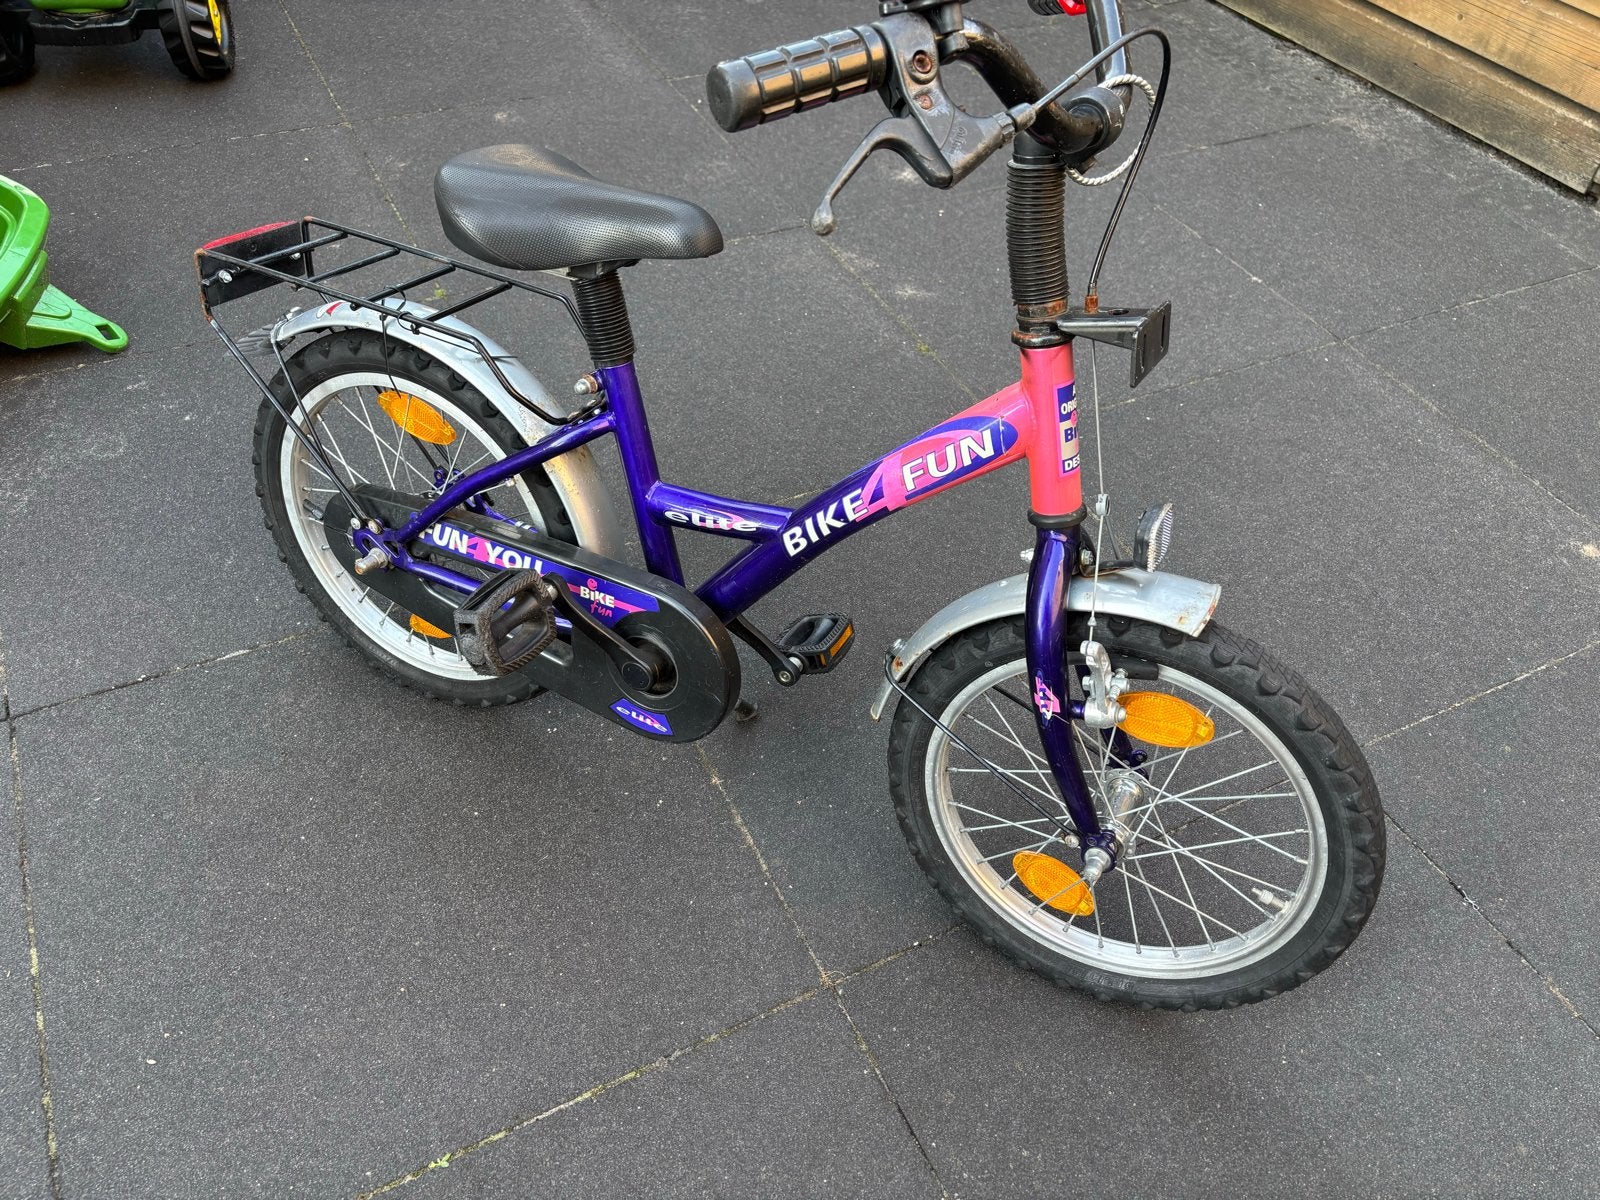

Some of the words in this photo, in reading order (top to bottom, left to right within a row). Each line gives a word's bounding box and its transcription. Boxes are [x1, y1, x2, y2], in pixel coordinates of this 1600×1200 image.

[782, 487, 869, 557] BIKE
[902, 429, 995, 492] FUN
[664, 509, 760, 532] elite
[485, 541, 543, 574] YOU
